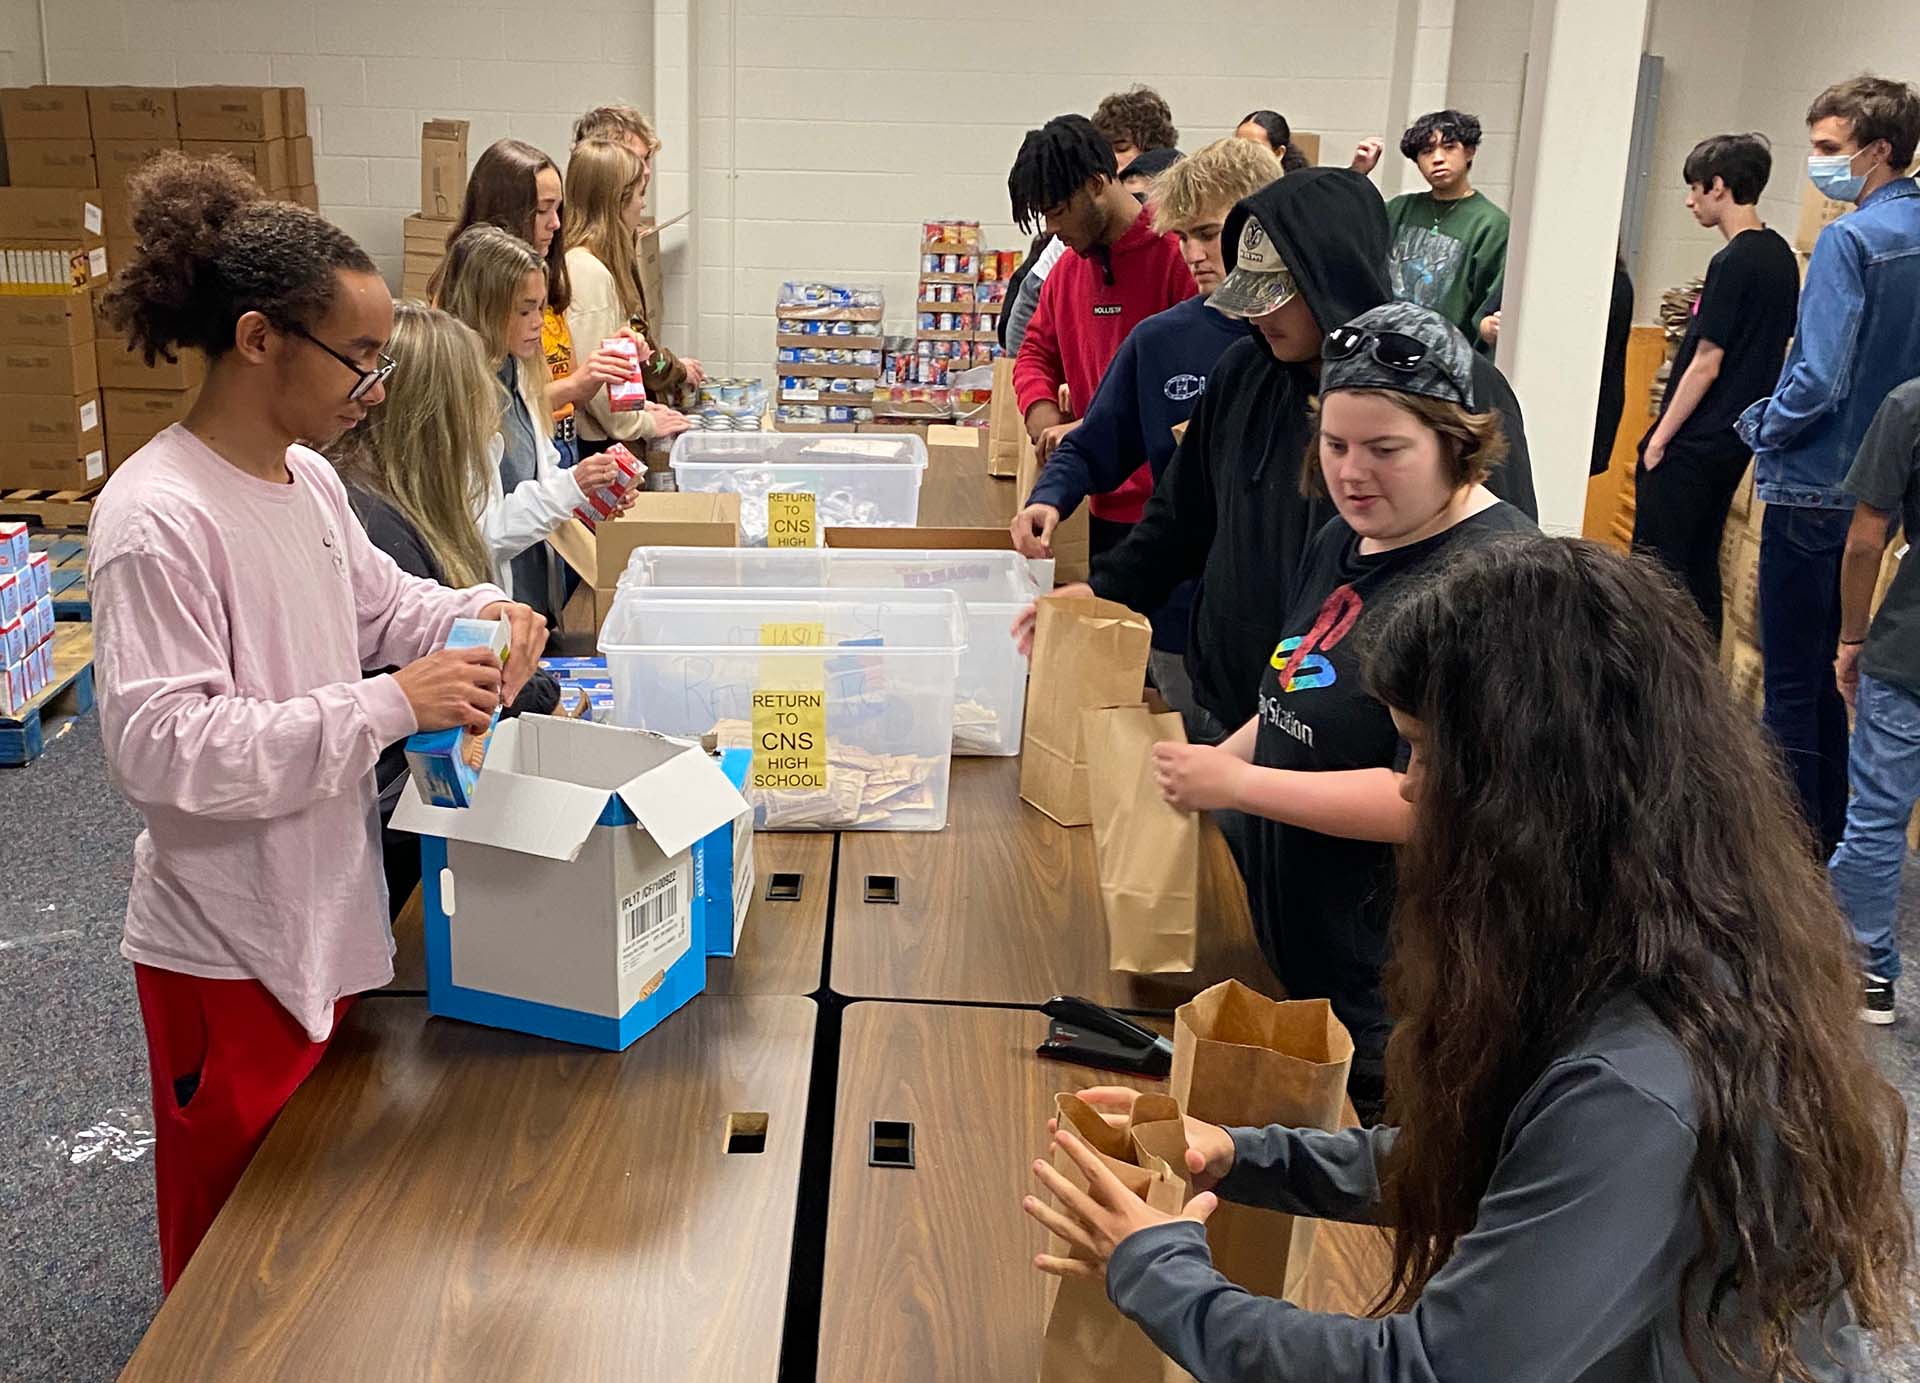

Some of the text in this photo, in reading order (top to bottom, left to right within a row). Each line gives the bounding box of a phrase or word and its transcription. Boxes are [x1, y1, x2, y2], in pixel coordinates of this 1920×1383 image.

[768, 493, 815, 502] RETURN
[784, 505, 800, 515] TO
[774, 520, 810, 533] CNS
[778, 537, 806, 547] HIGH
[753, 695, 820, 707] RETURN
[776, 712, 798, 725] TO
[762, 732, 813, 750] CNS
[768, 757, 808, 769] HIGH
[754, 774, 823, 786] SCHOOL
